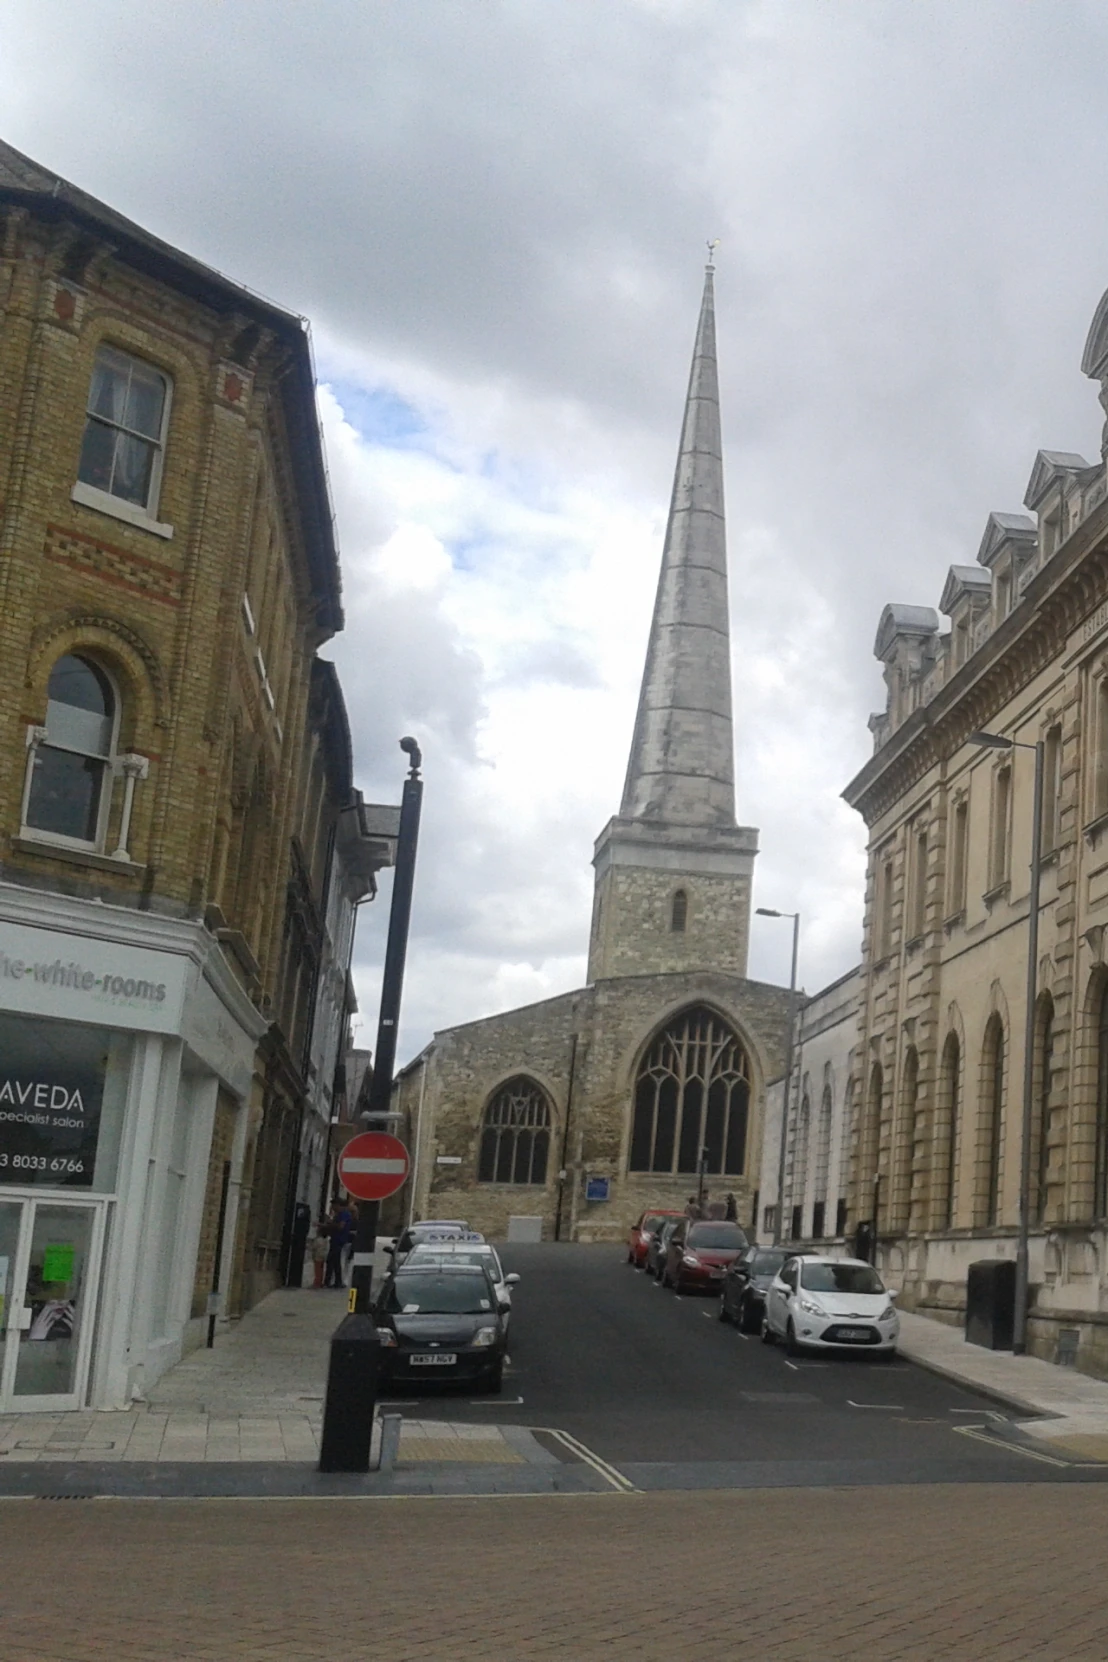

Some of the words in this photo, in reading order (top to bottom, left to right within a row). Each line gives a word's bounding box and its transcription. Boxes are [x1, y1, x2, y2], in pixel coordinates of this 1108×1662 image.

[0, 1080, 84, 1112] AVEDA
[52, 1116, 84, 1128] salon
[12, 1154, 47, 1170] 8033
[50, 1158, 84, 1173] 6766
